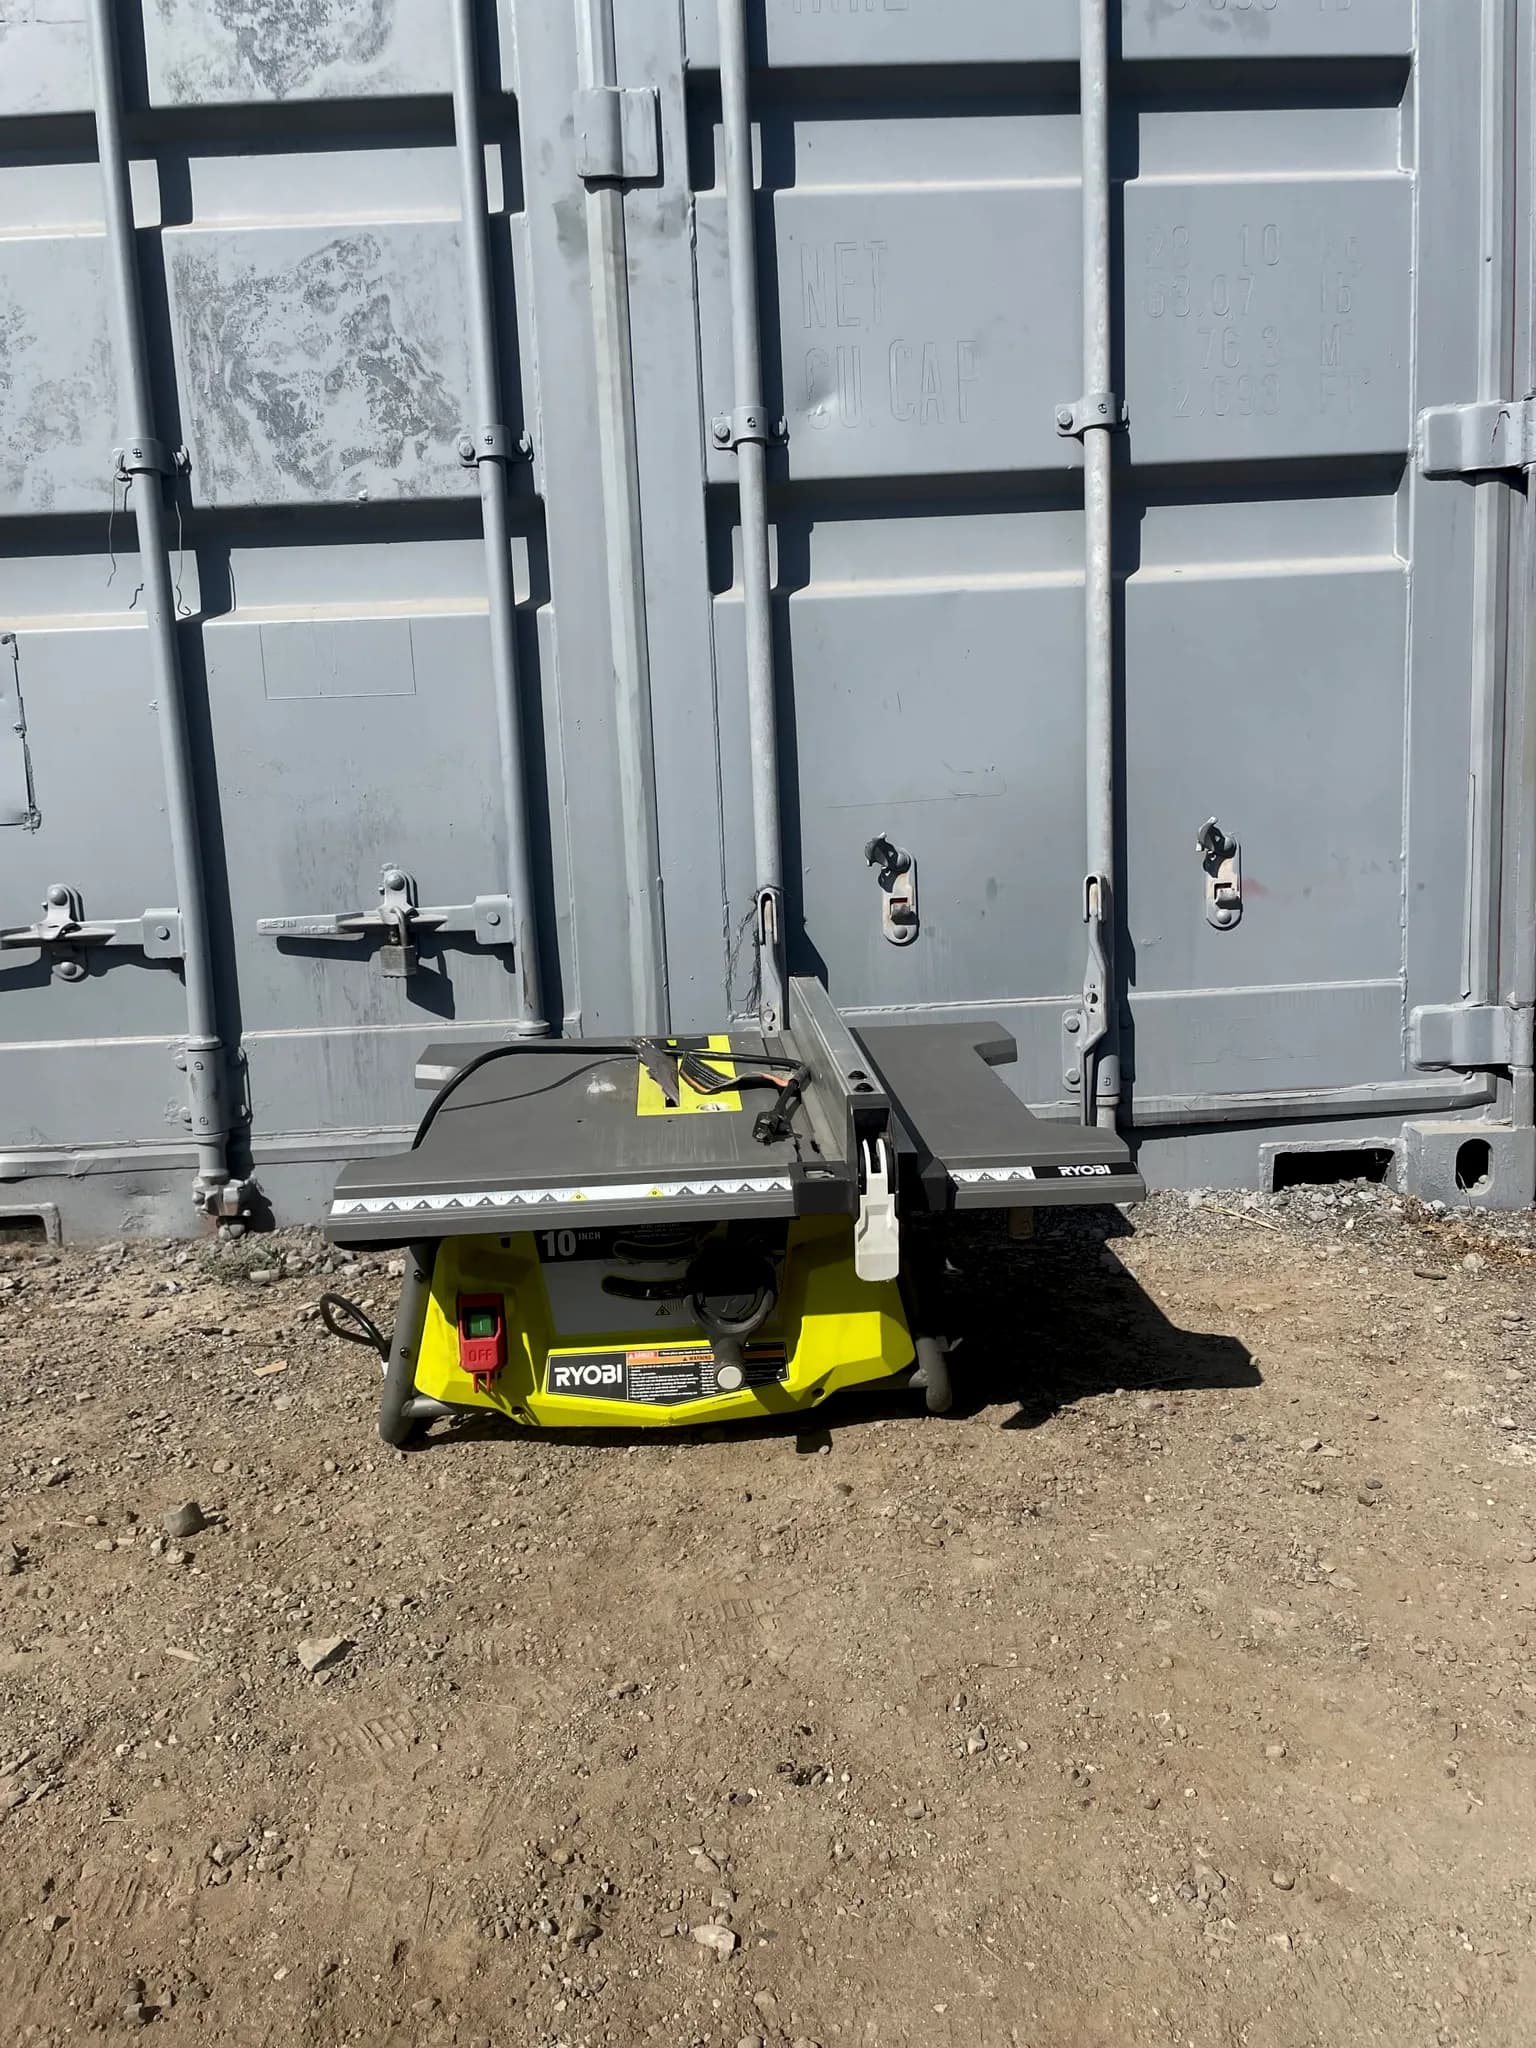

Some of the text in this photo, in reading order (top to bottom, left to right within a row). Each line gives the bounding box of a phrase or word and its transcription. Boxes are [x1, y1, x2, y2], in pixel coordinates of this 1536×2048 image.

[800, 240, 889, 328] NET
[1057, 1164, 1112, 1177] RYOBI
[542, 1230, 601, 1257] 10 INCH
[468, 1349, 493, 1362] OFF
[554, 1363, 623, 1387] RYOBI
